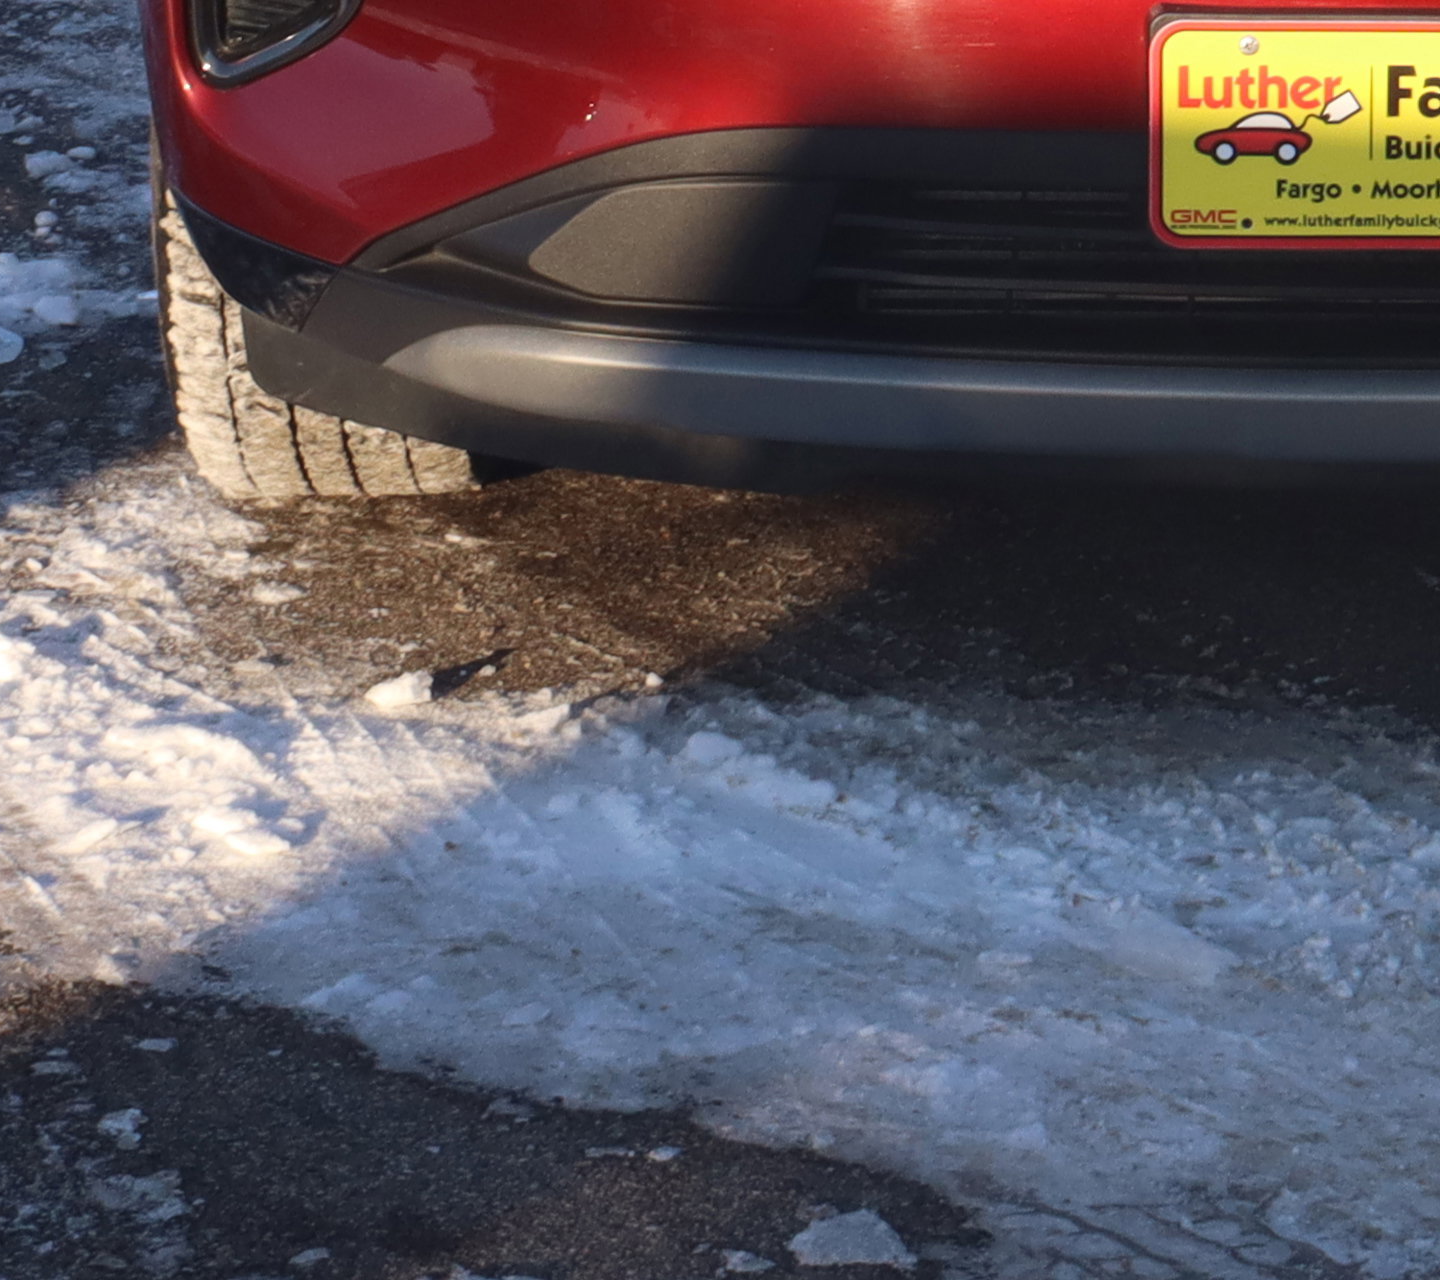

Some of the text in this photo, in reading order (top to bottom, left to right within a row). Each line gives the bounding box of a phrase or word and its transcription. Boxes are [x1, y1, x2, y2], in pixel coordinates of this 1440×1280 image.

[1177, 64, 1343, 109] Luther
[1275, 179, 1342, 203] Fargo
[1171, 209, 1237, 224] GMC
